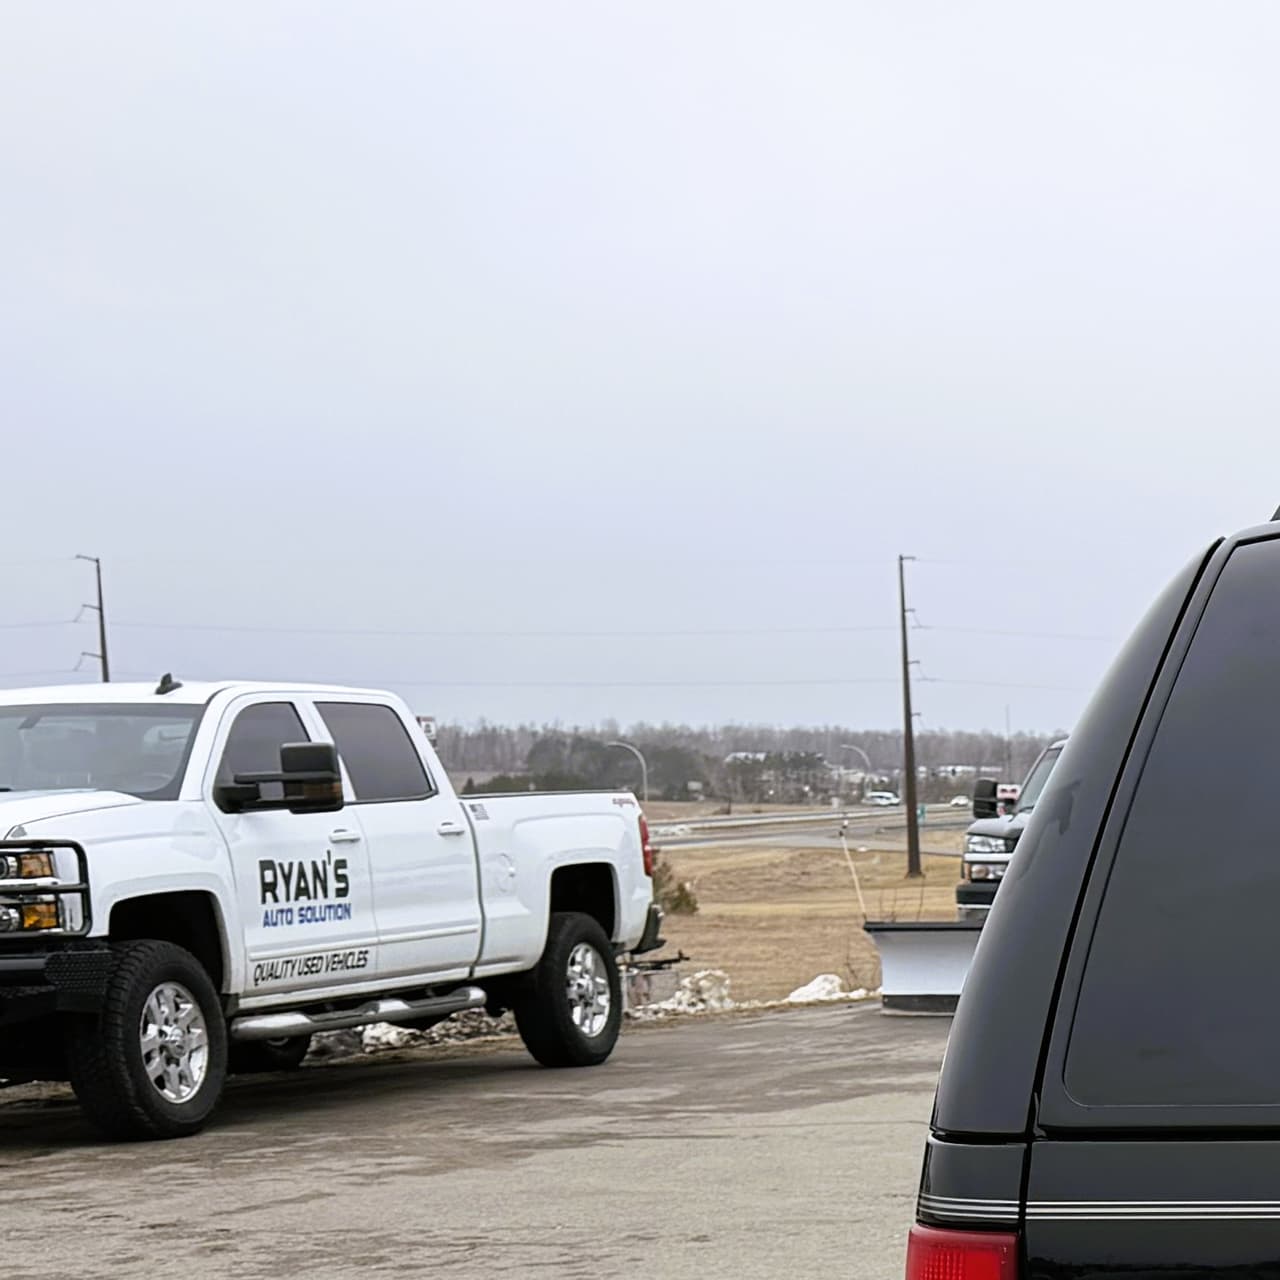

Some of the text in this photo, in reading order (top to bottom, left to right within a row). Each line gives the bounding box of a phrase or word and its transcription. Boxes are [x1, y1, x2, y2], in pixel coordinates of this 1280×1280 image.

[258, 849, 350, 905] RYAN'S
[263, 903, 352, 928] AUTO SOLUTION
[253, 950, 369, 987] QUALITY USED VEHICLES
